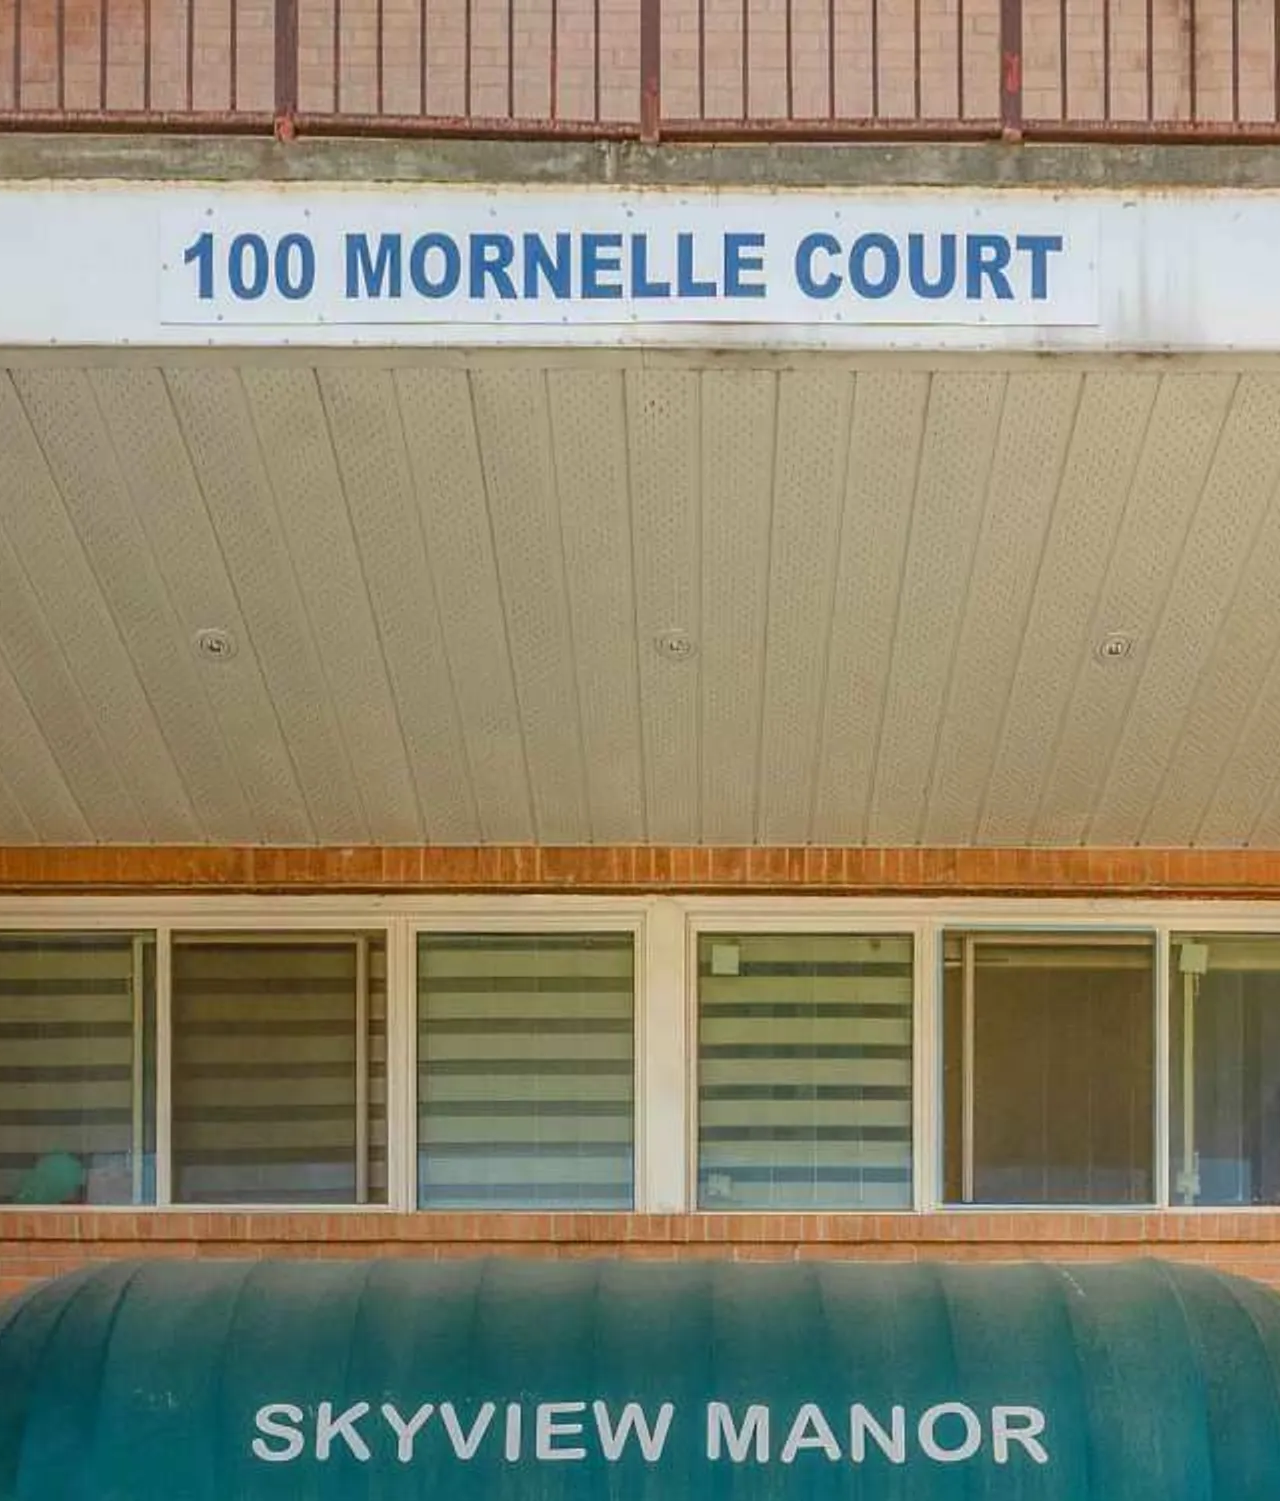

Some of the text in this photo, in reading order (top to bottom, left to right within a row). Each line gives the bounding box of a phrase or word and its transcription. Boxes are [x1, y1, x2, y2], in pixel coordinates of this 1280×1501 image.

[184, 231, 1064, 301] 100 MORNELLE COURT
[251, 1400, 1050, 1464] SKYVIEW MANOR
